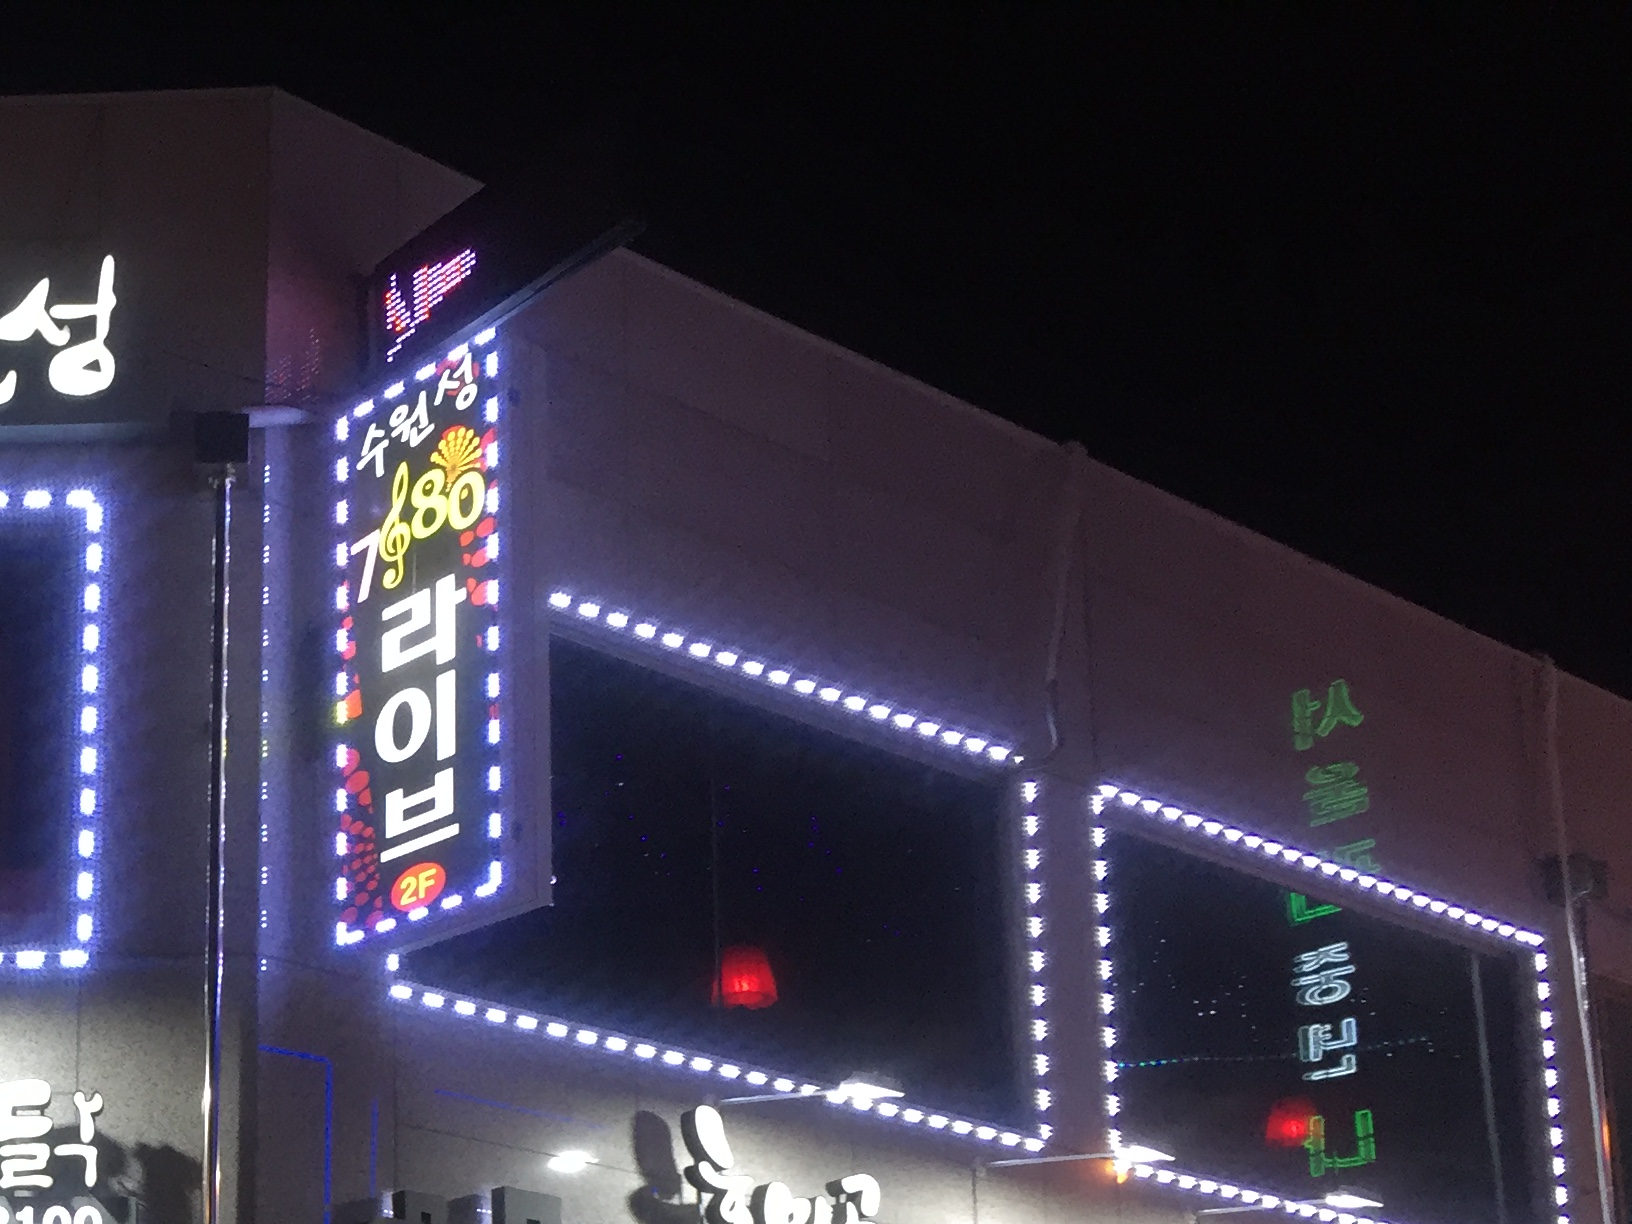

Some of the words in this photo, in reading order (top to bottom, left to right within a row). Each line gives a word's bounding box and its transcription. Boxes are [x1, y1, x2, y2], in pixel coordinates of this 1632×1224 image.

[355, 351, 479, 478] 수원성
[375, 574, 467, 864] 라이브
[399, 868, 437, 906] 2F
